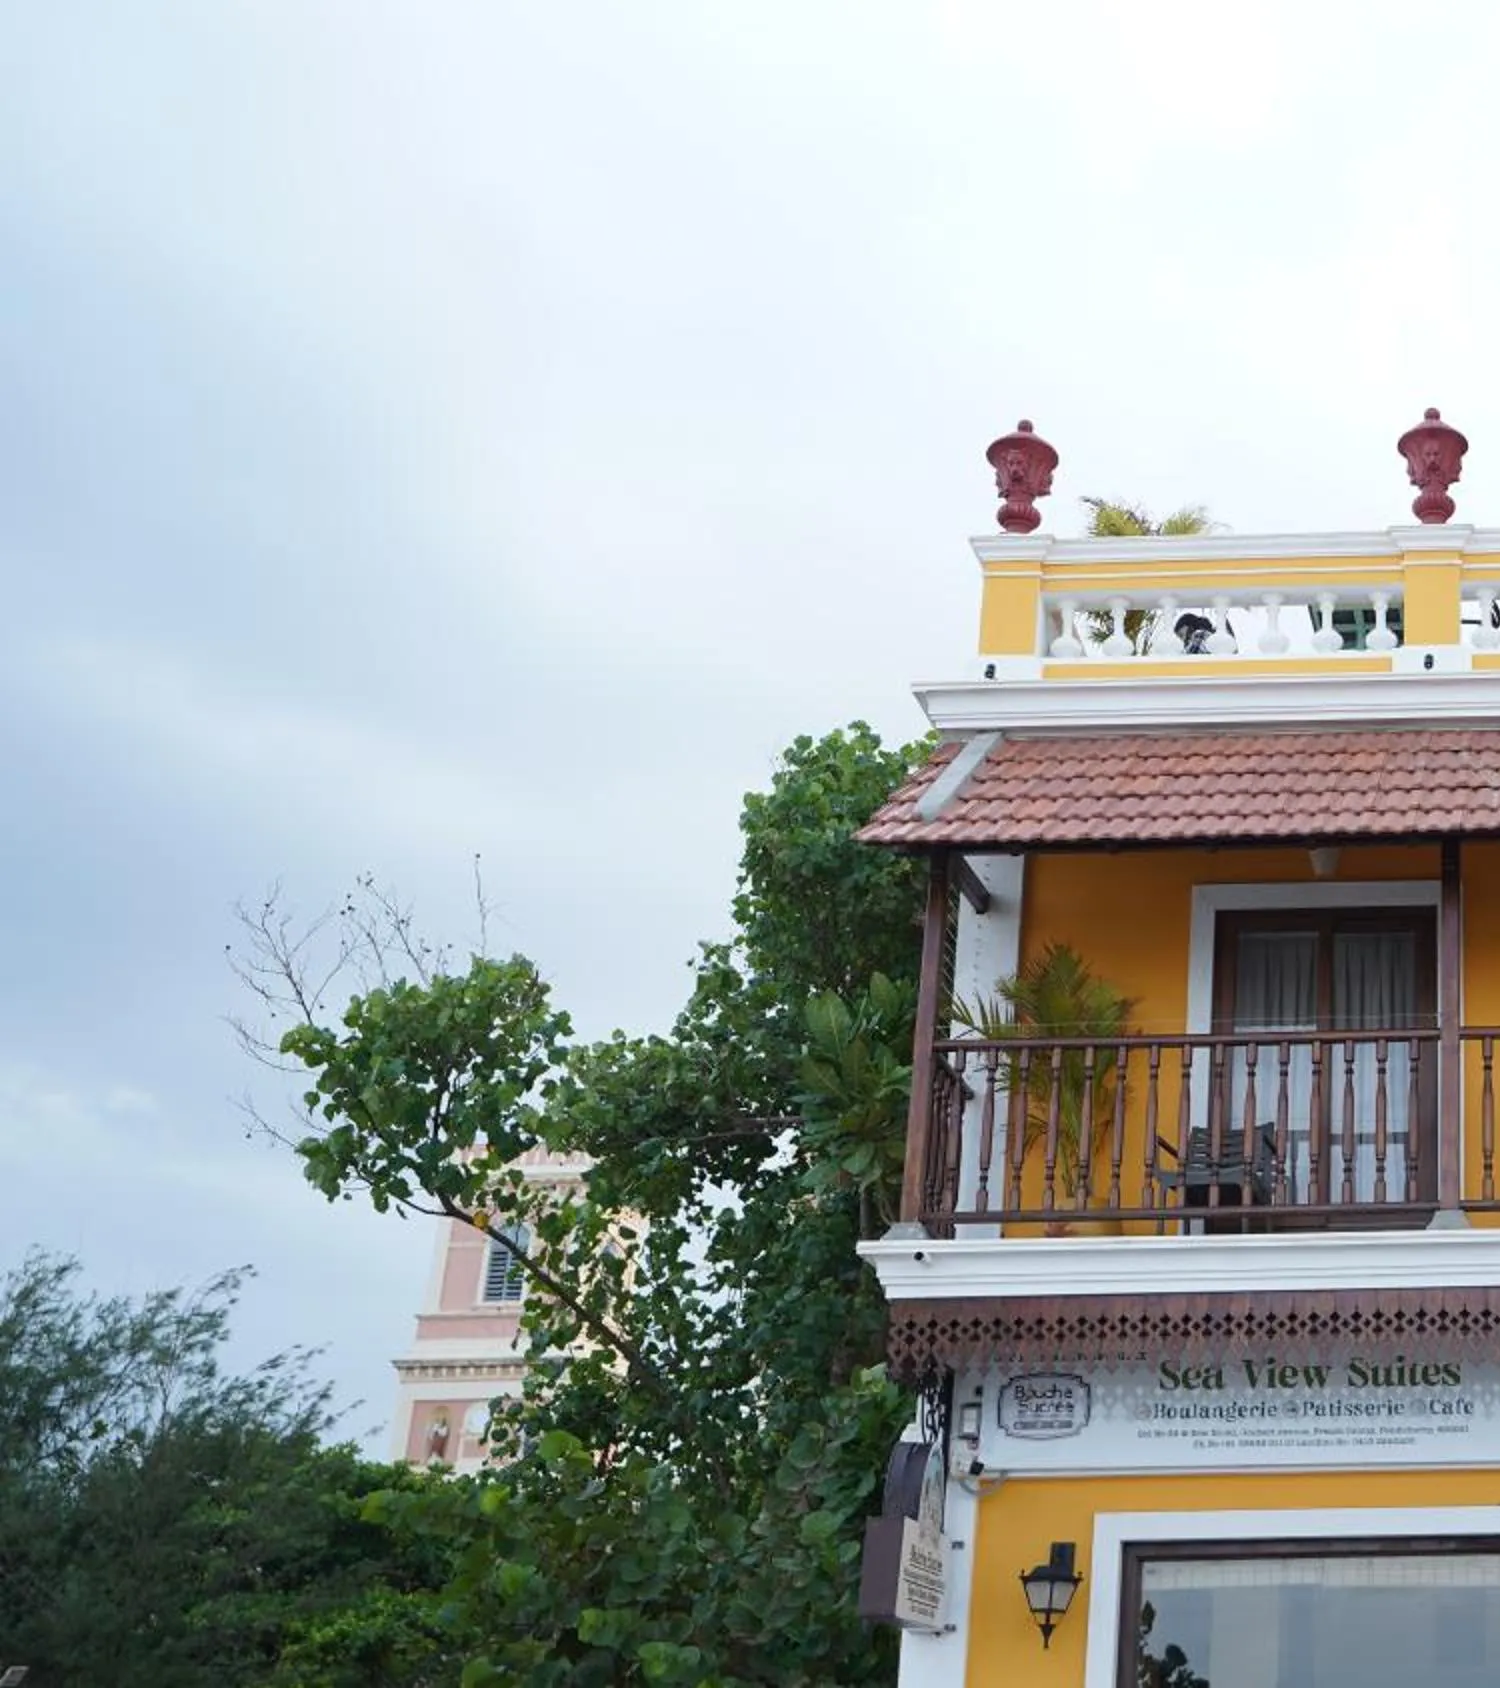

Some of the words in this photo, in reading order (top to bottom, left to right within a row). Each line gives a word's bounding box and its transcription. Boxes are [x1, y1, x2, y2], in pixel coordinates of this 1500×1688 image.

[1158, 1358, 1225, 1391] Sea
[1241, 1356, 1332, 1389] View
[1347, 1355, 1462, 1388] Suites
[1153, 1400, 1278, 1423] Boulangerie
[1302, 1399, 1405, 1417] Patisserie
[1429, 1398, 1475, 1415] Cafe
